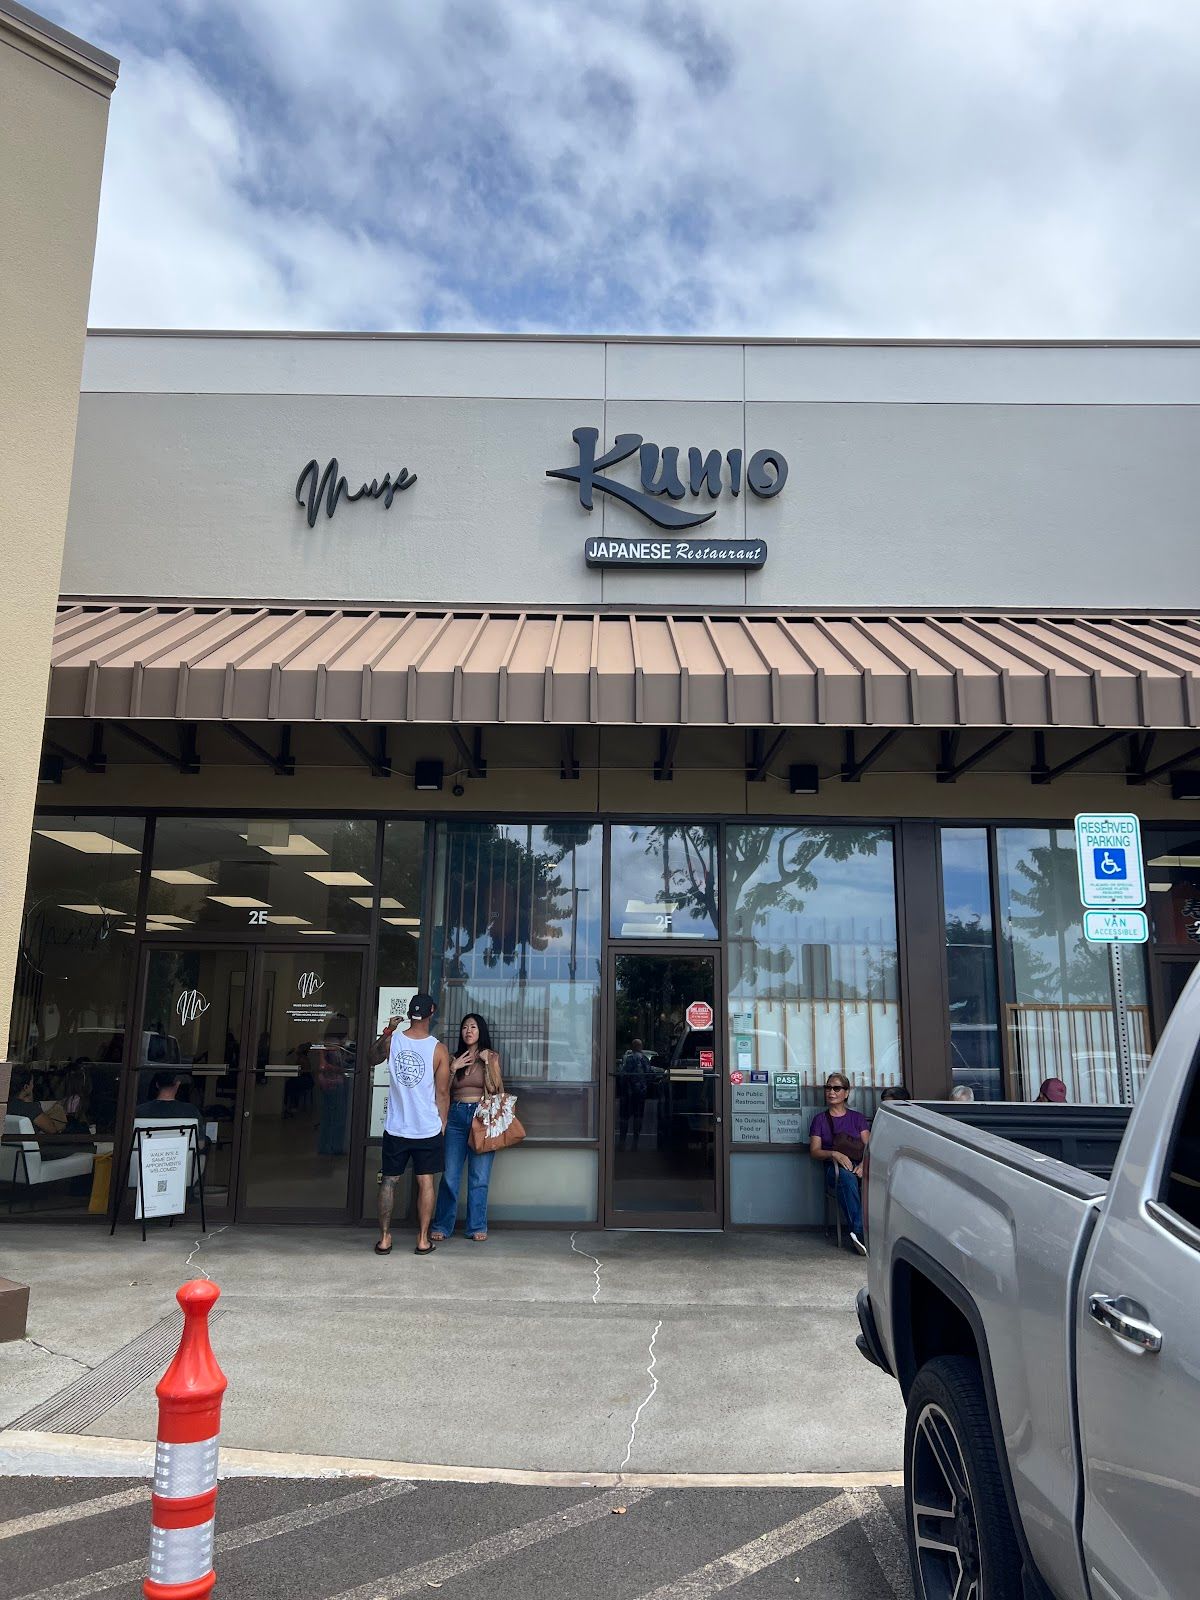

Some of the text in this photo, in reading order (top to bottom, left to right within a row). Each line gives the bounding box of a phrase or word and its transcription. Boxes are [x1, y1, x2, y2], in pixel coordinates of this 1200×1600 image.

[296, 457, 417, 528] Muse
[589, 542, 761, 560] JAPANESE Restaurant
[1081, 822, 1134, 834] RESERVED
[1087, 835, 1131, 847] PARKING
[248, 910, 268, 926] 2E
[655, 915, 672, 928] 2F
[1104, 918, 1127, 928] VAN
[1094, 928, 1139, 936] ACCESSIBLE
[777, 1076, 797, 1084] PASS
